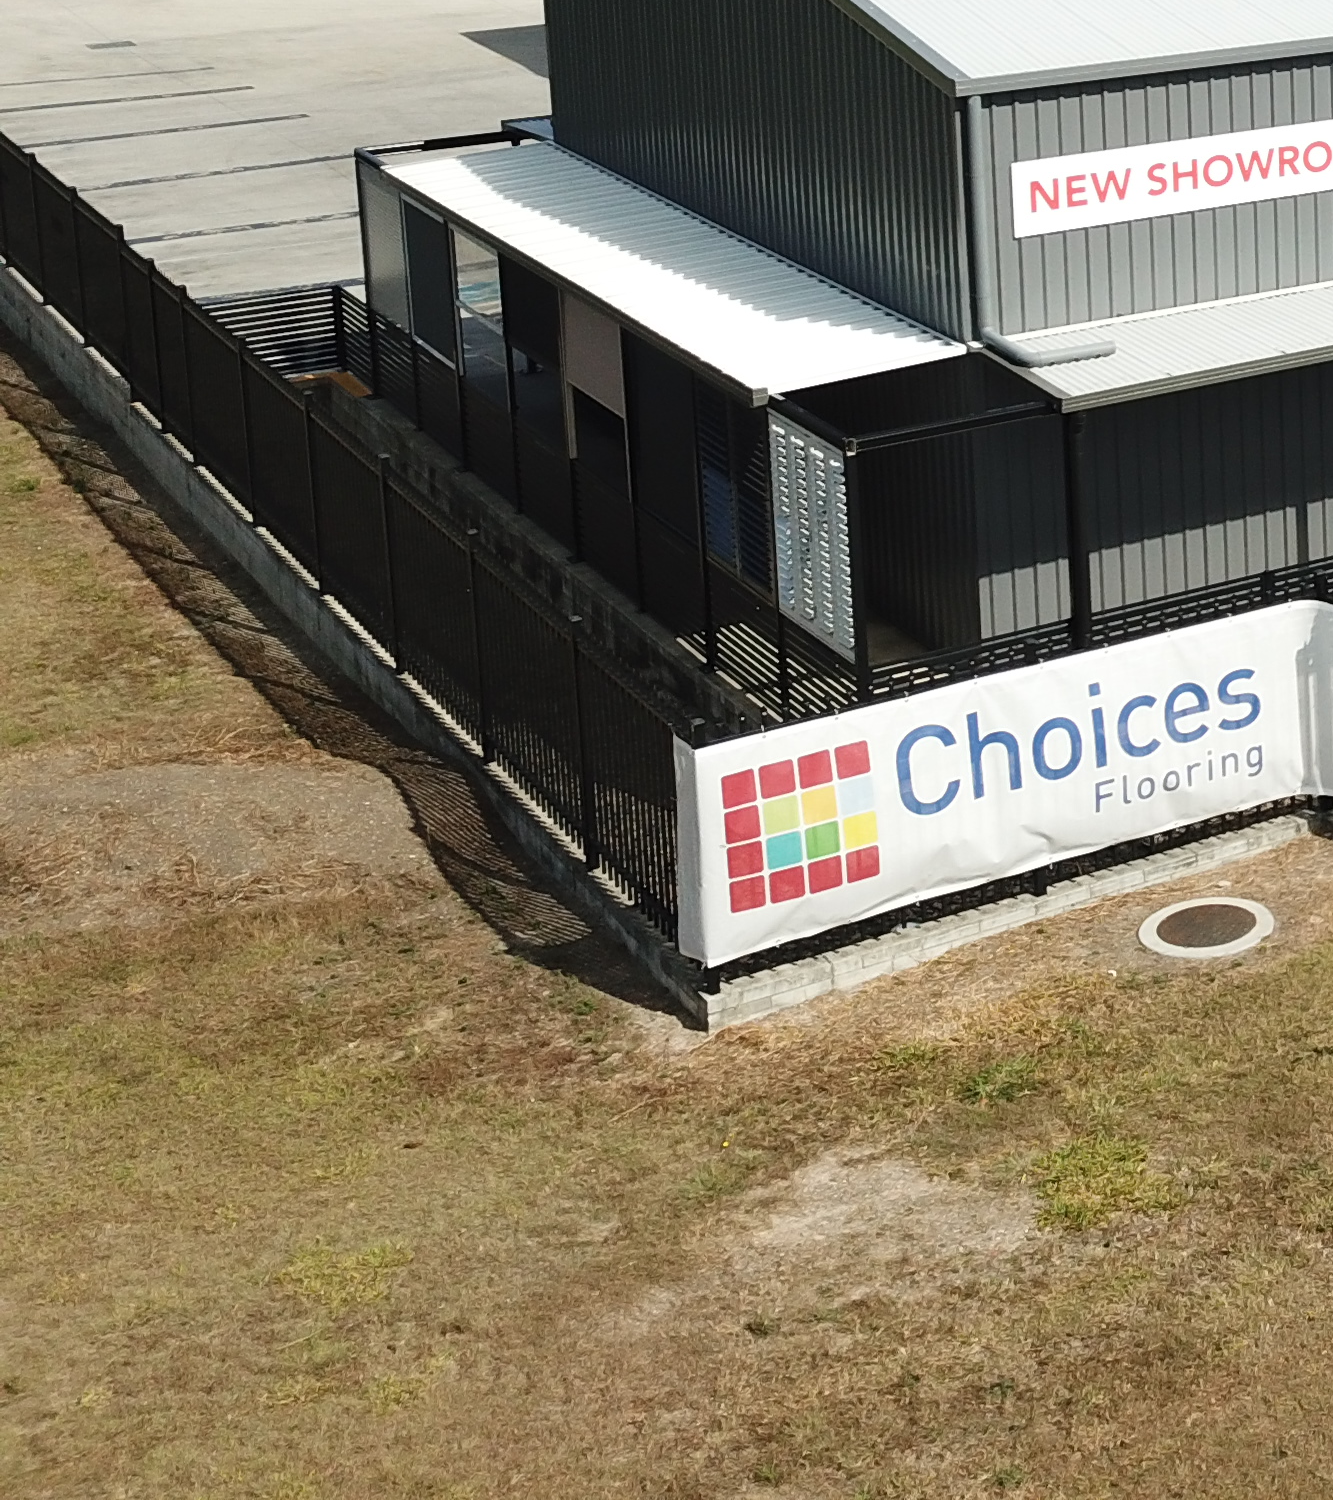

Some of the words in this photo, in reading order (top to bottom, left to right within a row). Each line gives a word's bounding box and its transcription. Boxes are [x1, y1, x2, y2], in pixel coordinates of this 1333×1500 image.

[1029, 168, 1131, 213] NEW
[896, 667, 1263, 816] Choices
[1095, 743, 1264, 813] Flooring
